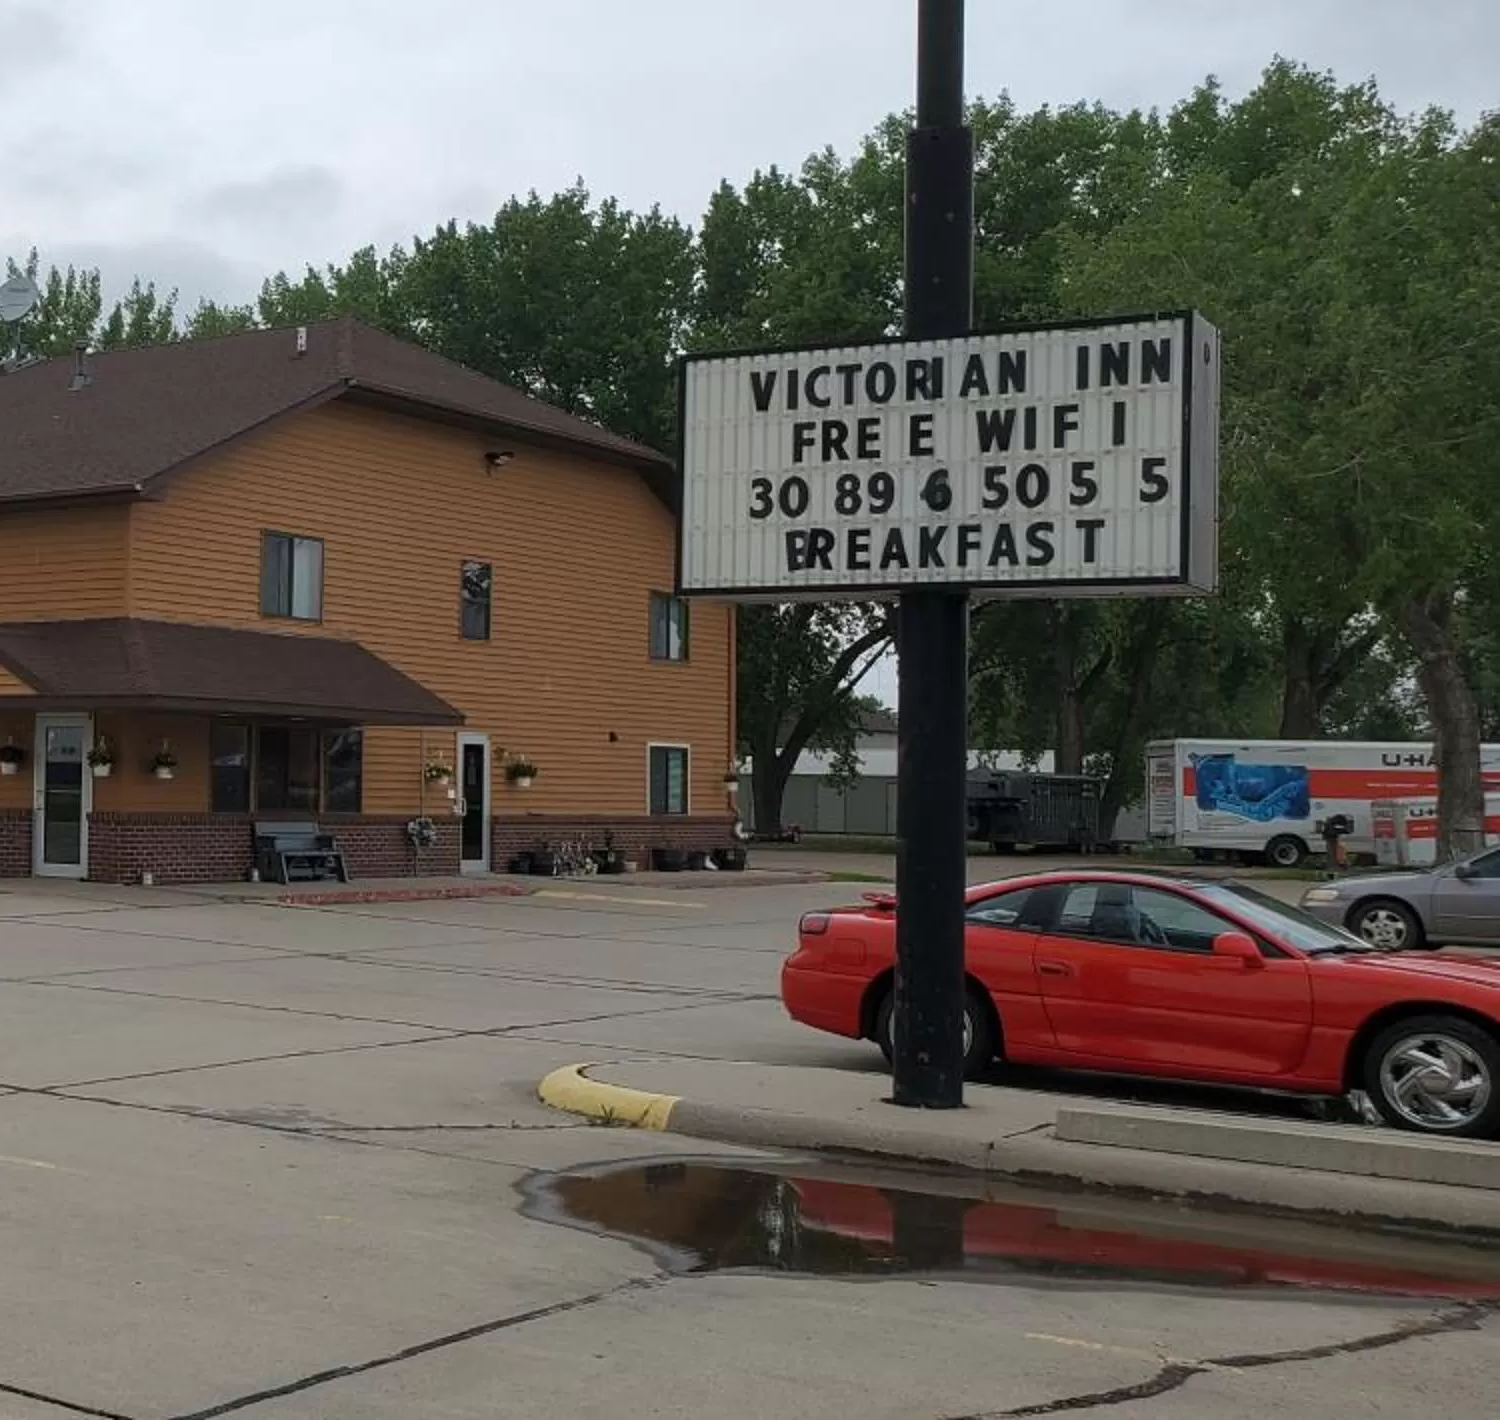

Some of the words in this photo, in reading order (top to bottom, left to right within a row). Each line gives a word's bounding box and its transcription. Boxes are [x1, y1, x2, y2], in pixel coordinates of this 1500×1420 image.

[749, 349, 1027, 413] VICTORIAN
[1076, 337, 1172, 391] INN
[792, 413, 935, 464] FREE
[975, 401, 1126, 454] WIFI
[785, 519, 1105, 573] BREAKFAST
